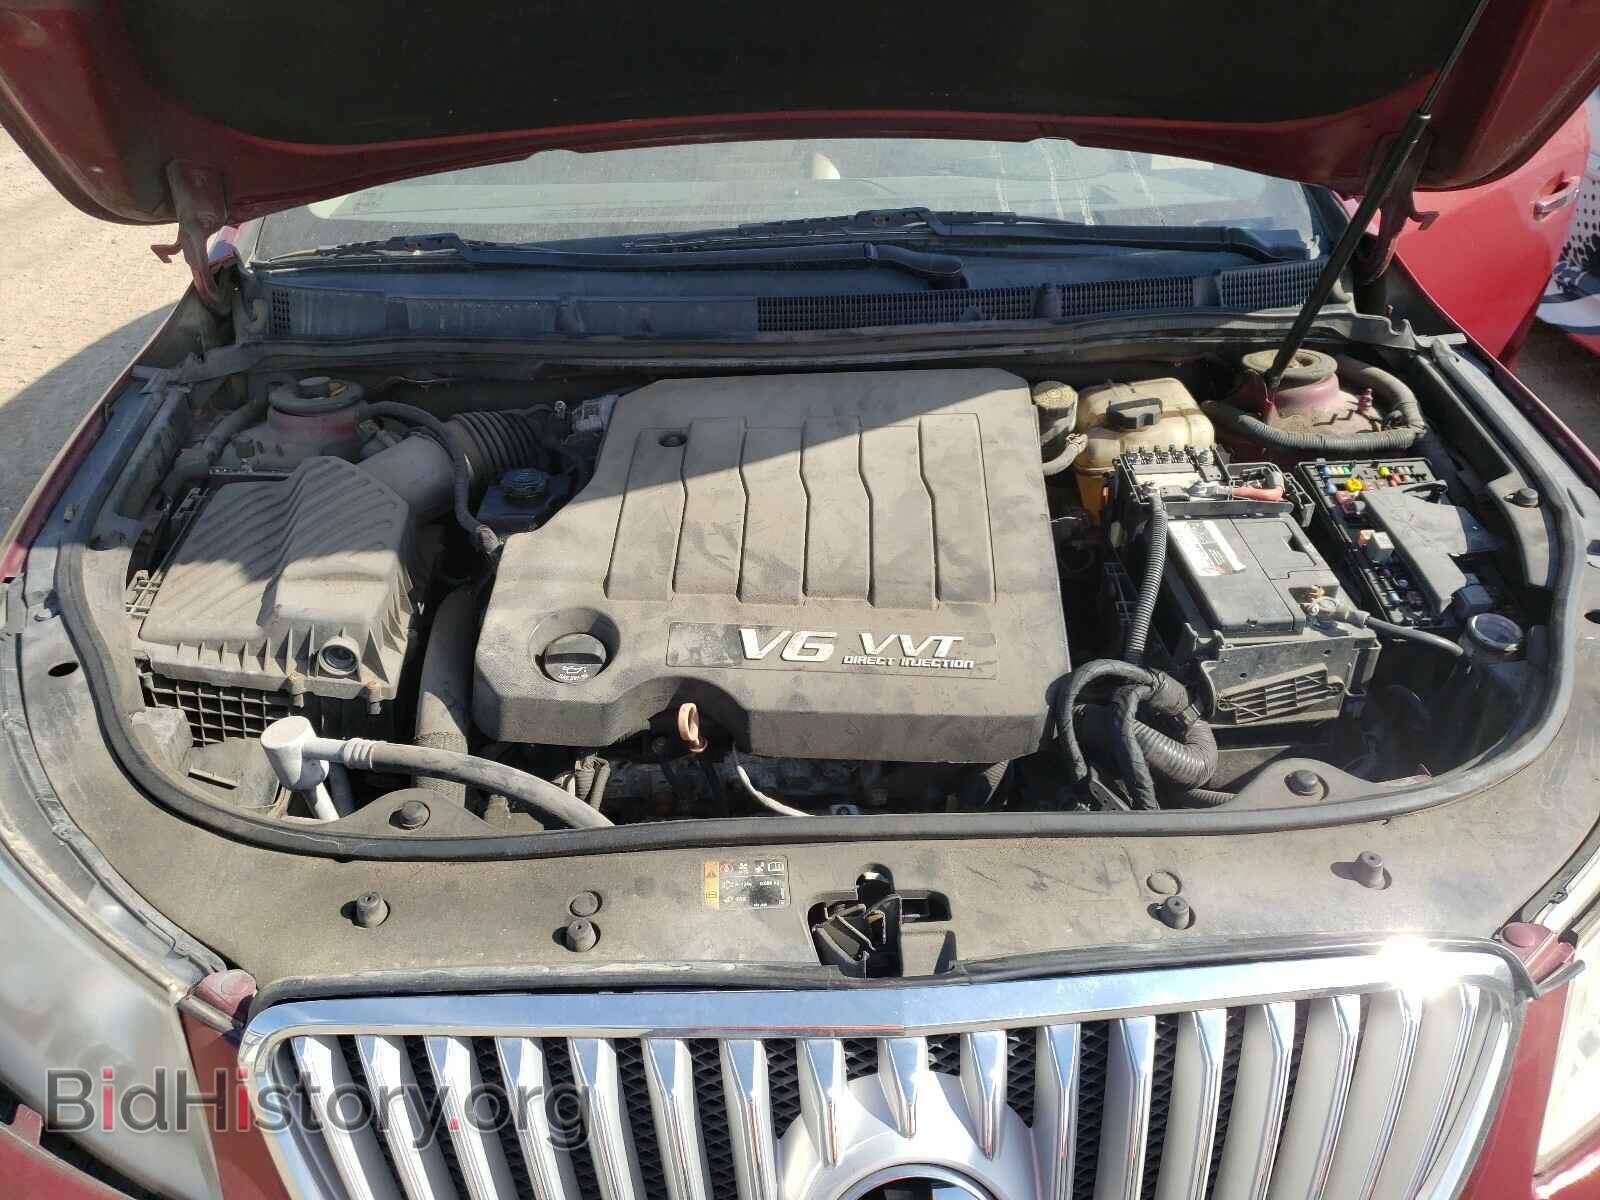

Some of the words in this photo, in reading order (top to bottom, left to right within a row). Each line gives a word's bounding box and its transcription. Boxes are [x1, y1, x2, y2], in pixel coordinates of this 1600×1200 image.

[738, 628, 838, 662] V6
[859, 632, 964, 658] VVT
[842, 655, 895, 666] DIRECT
[901, 657, 975, 669] INJECTION
